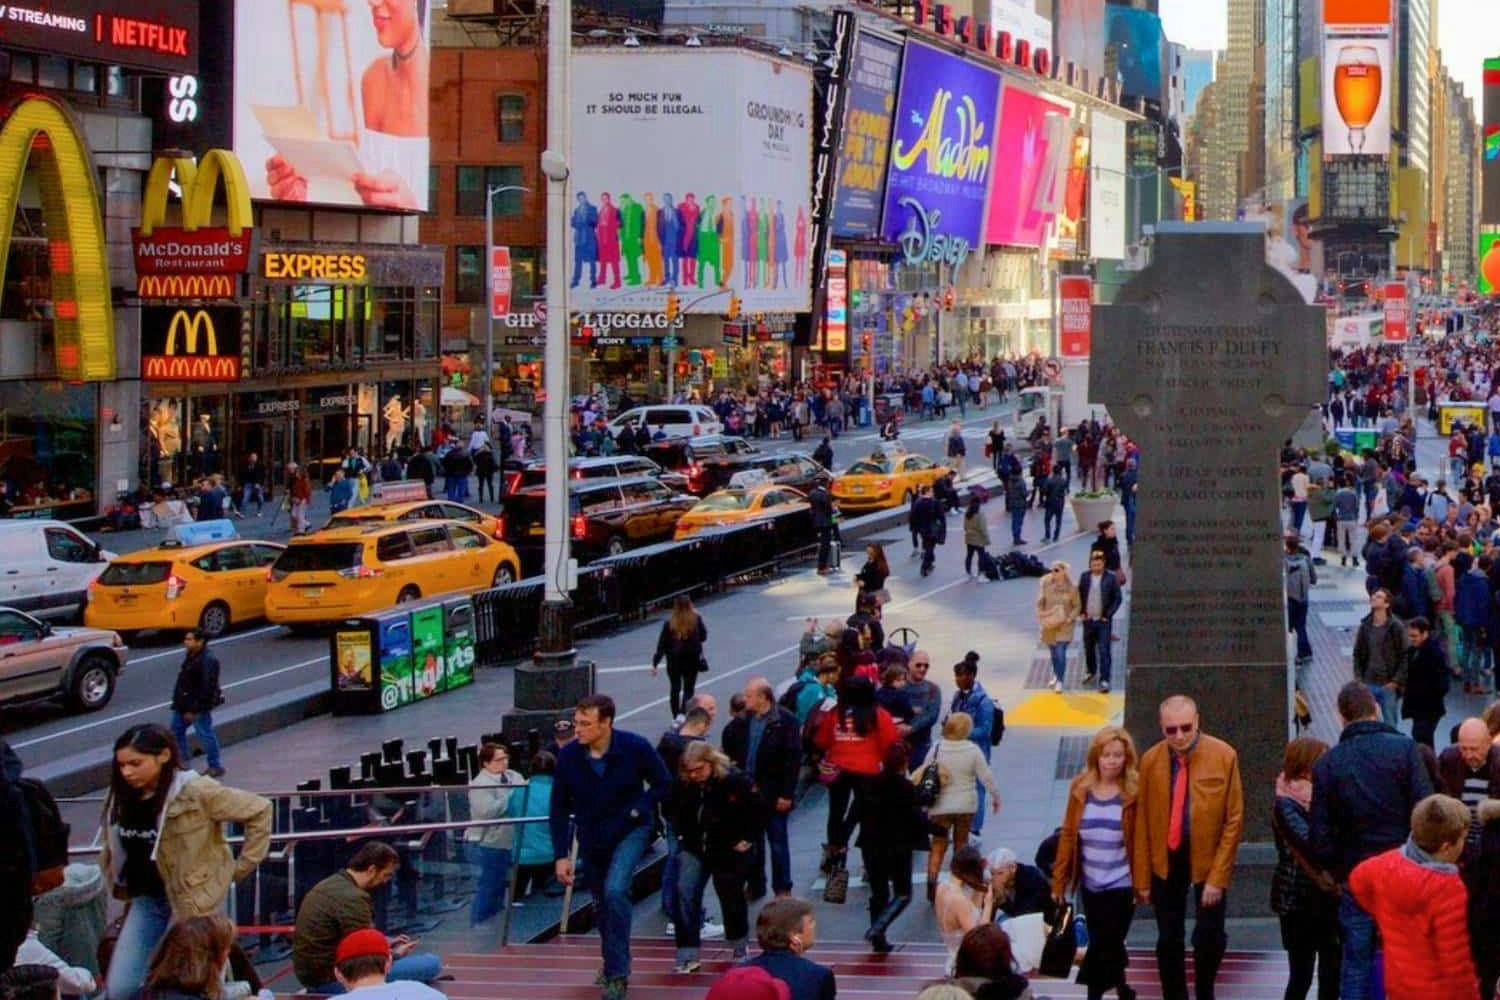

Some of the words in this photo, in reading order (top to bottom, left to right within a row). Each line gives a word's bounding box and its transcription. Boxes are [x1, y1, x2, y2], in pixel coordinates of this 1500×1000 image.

[9, 7, 86, 33] STREAMING
[112, 18, 188, 56] NETFLIX
[608, 92, 624, 103] SO
[628, 92, 658, 103] MUCH
[663, 92, 682, 103] FUN
[586, 104, 597, 115] IT
[601, 104, 642, 115] SHOULD
[645, 104, 658, 115] BE
[894, 88, 990, 183] Aladdin
[138, 241, 243, 257] McDonald's
[155, 257, 226, 268] Restaurant
[265, 253, 368, 279] EXPRESS
[259, 400, 300, 414] EXPRESS
